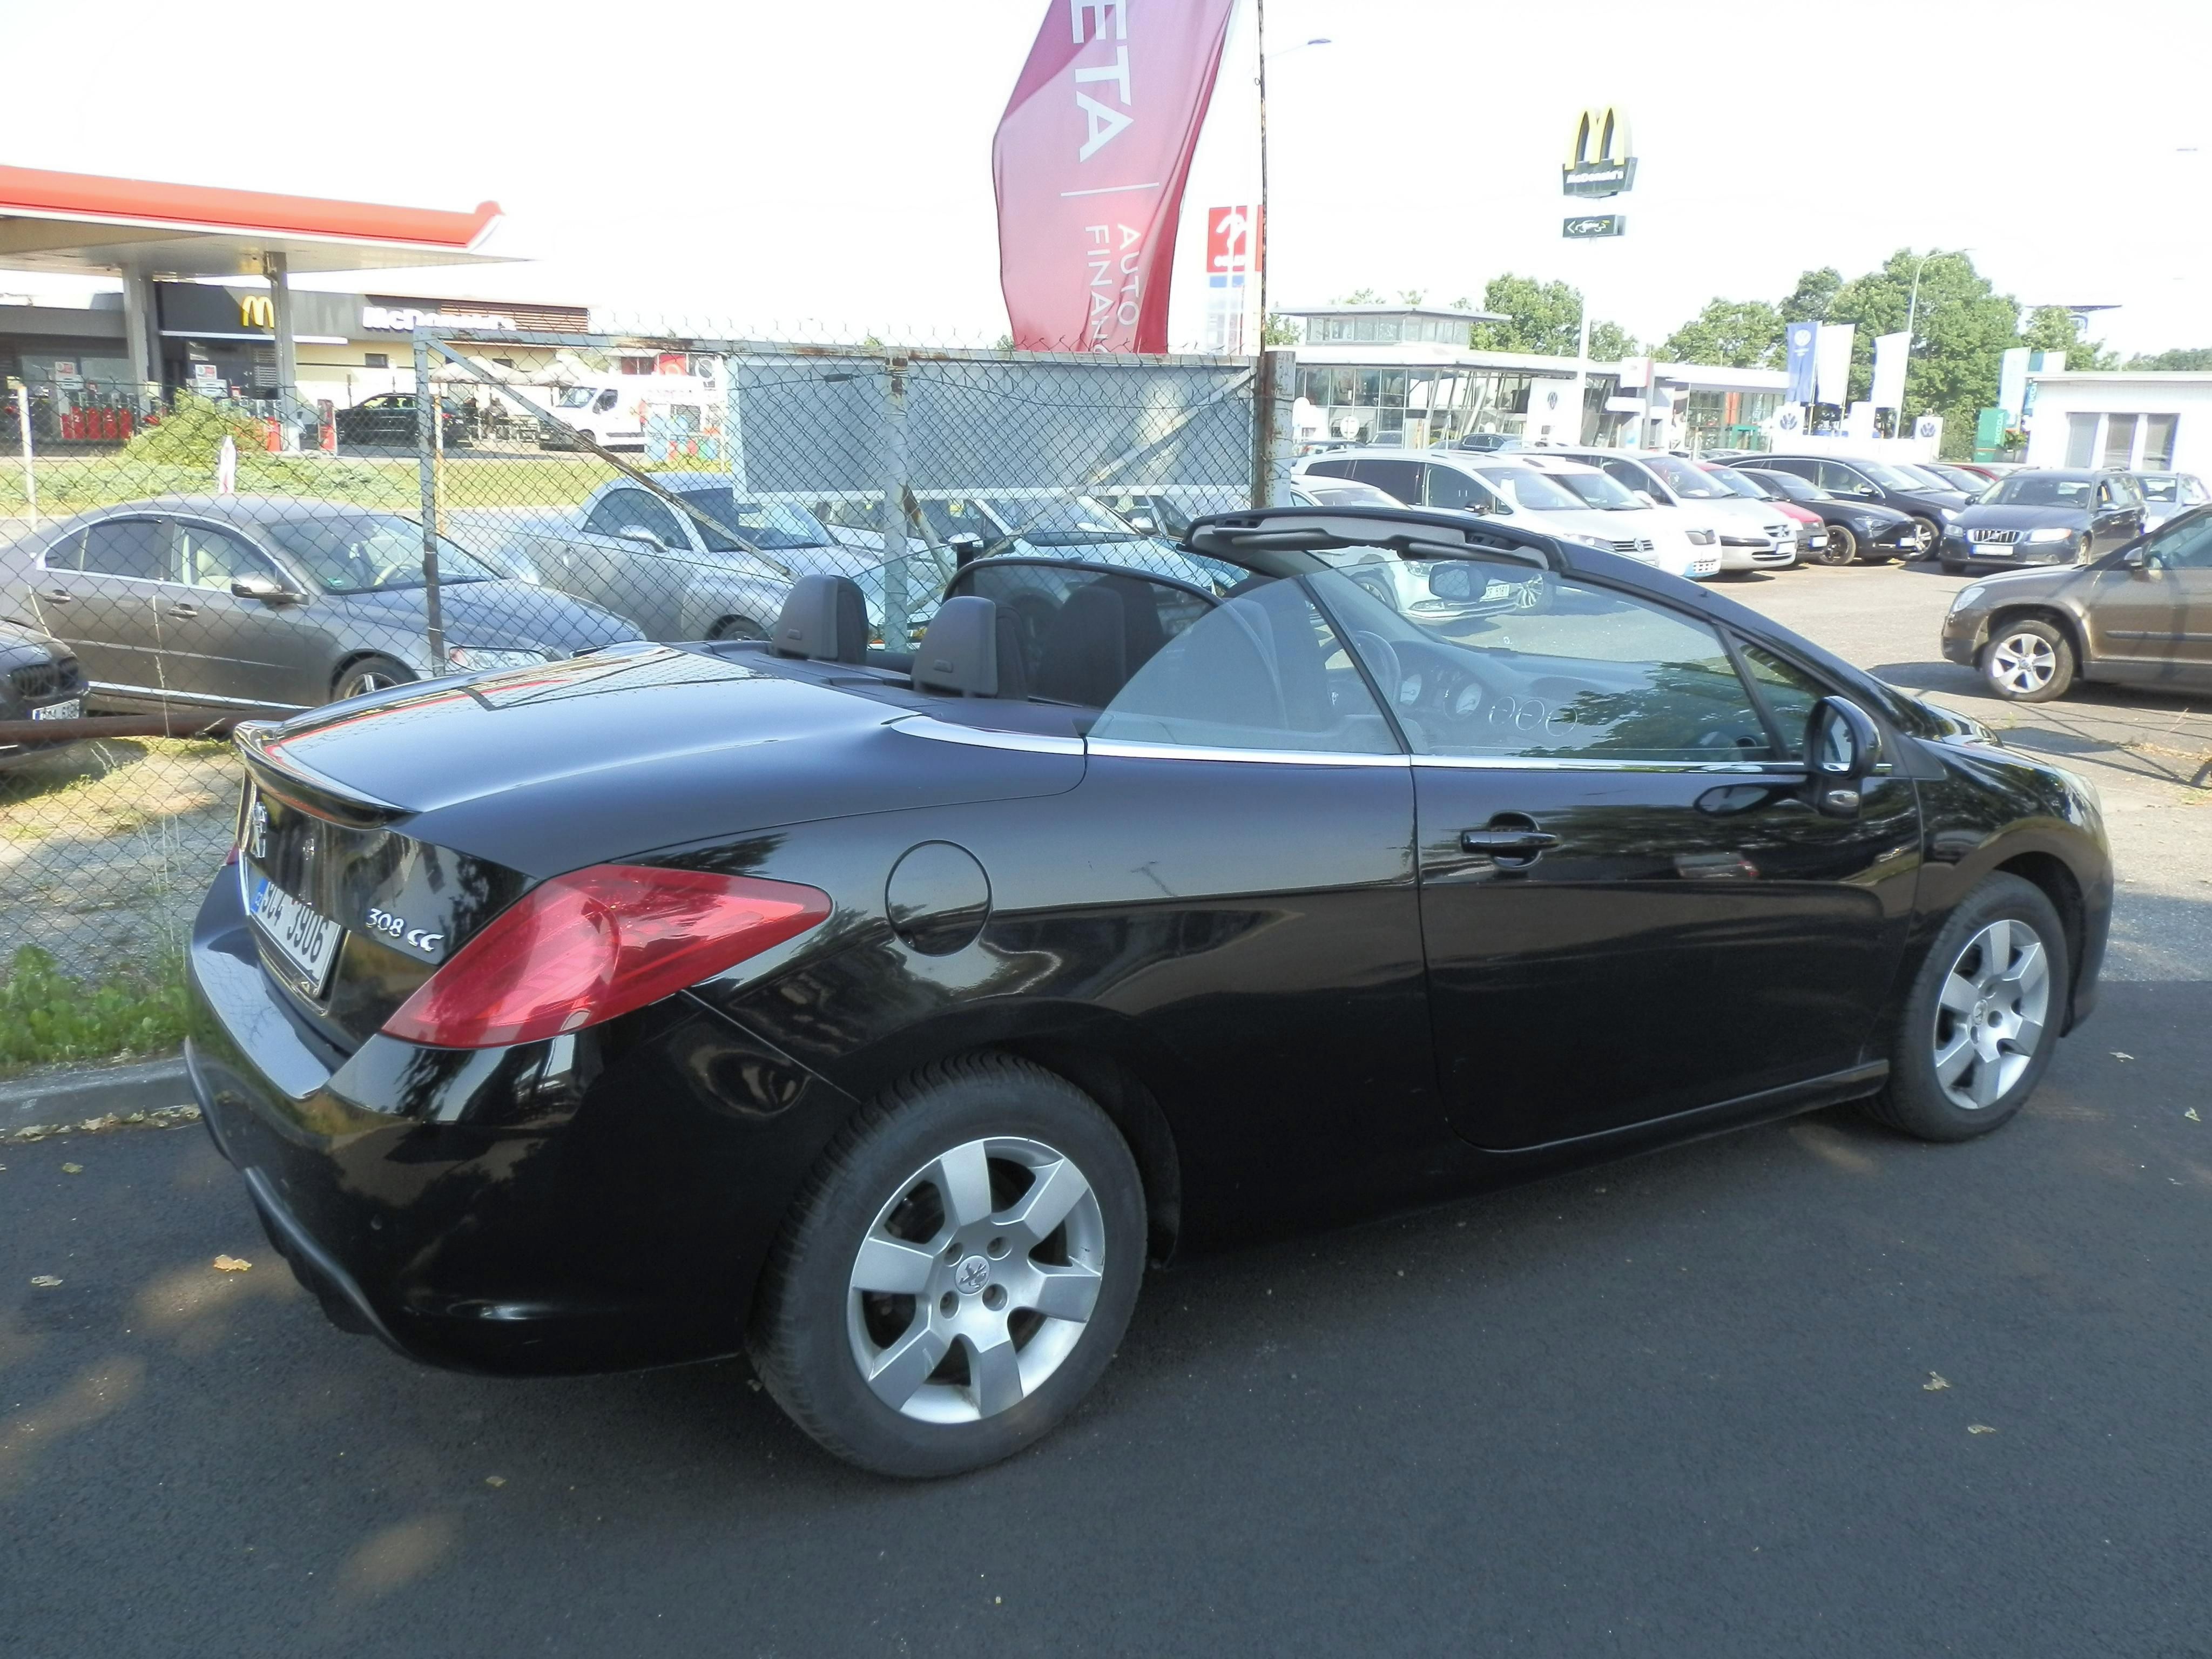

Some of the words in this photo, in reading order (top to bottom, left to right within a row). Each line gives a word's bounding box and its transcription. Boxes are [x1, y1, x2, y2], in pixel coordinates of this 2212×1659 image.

[1117, 224, 1141, 325] AUTO
[366, 908, 404, 938] 308
[407, 929, 444, 952] CC
